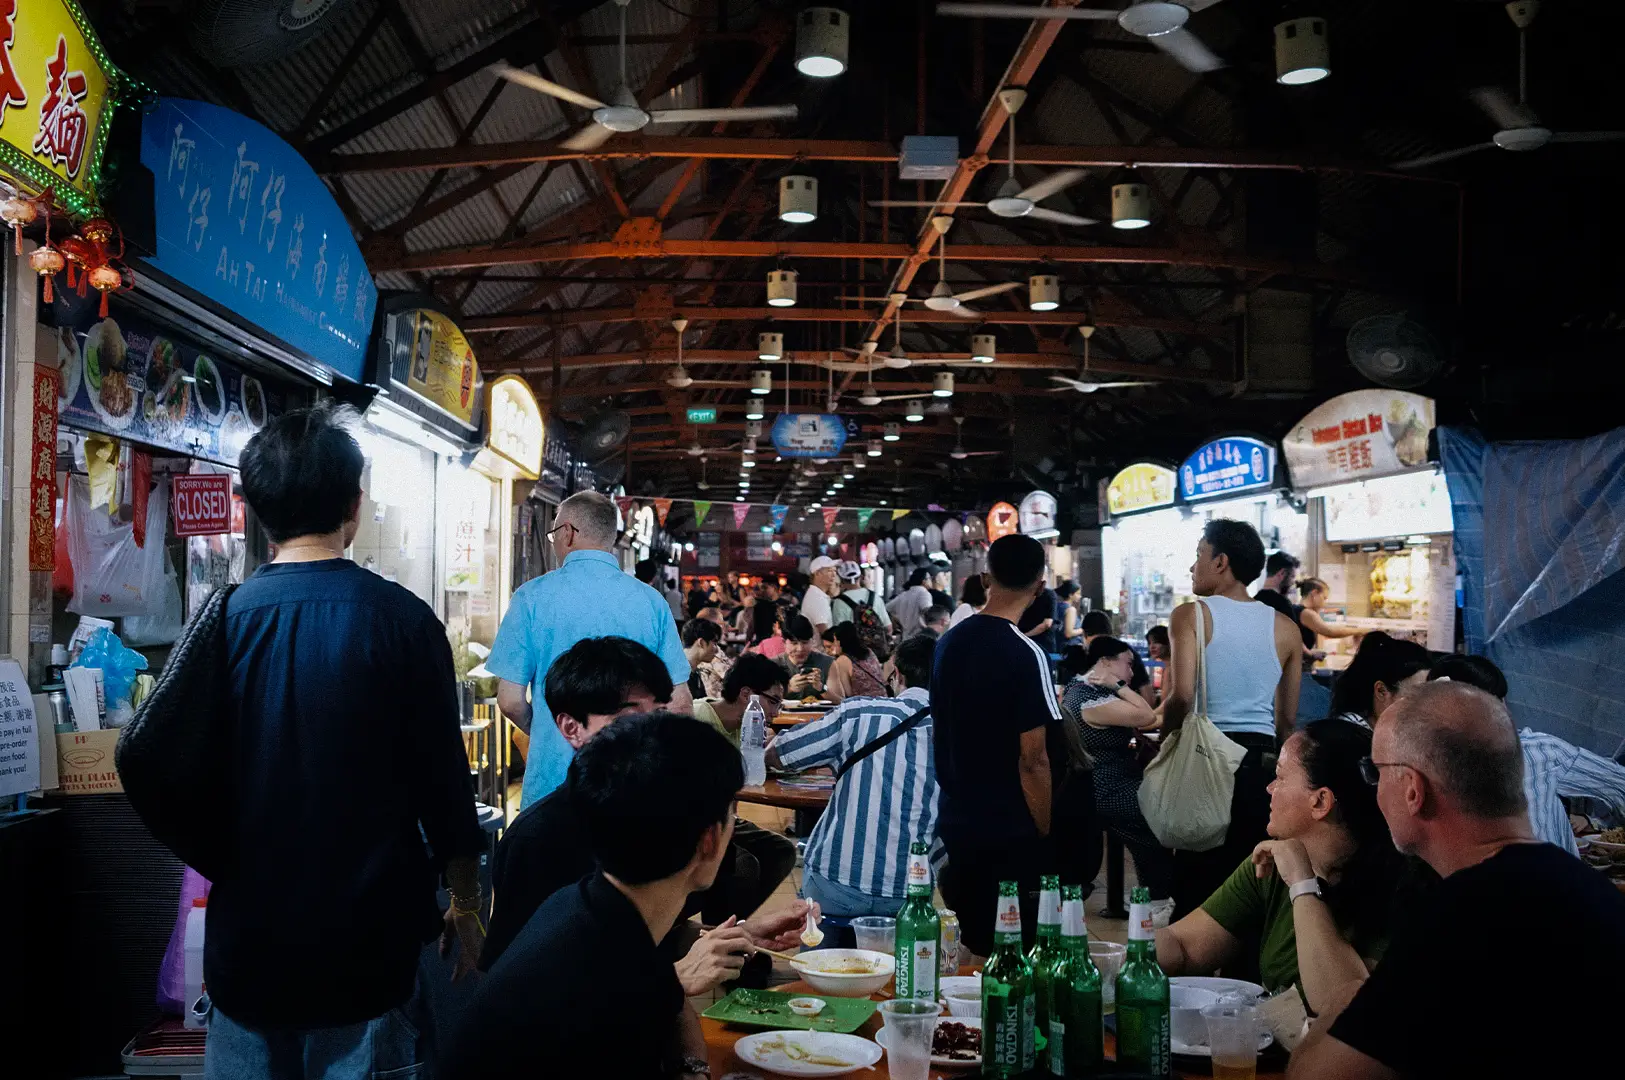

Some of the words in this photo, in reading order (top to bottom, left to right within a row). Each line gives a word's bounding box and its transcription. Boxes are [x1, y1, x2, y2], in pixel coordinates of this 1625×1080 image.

[177, 491, 227, 521] CLOSED
[3, 730, 14, 738] pay
[13, 764, 27, 775] you!
[88, 772, 117, 783] PLATE
[900, 946, 909, 997] TSINGTAO
[1005, 1004, 1018, 1065] TSINGTAO
[1160, 1012, 1170, 1076] TSINGTAO
